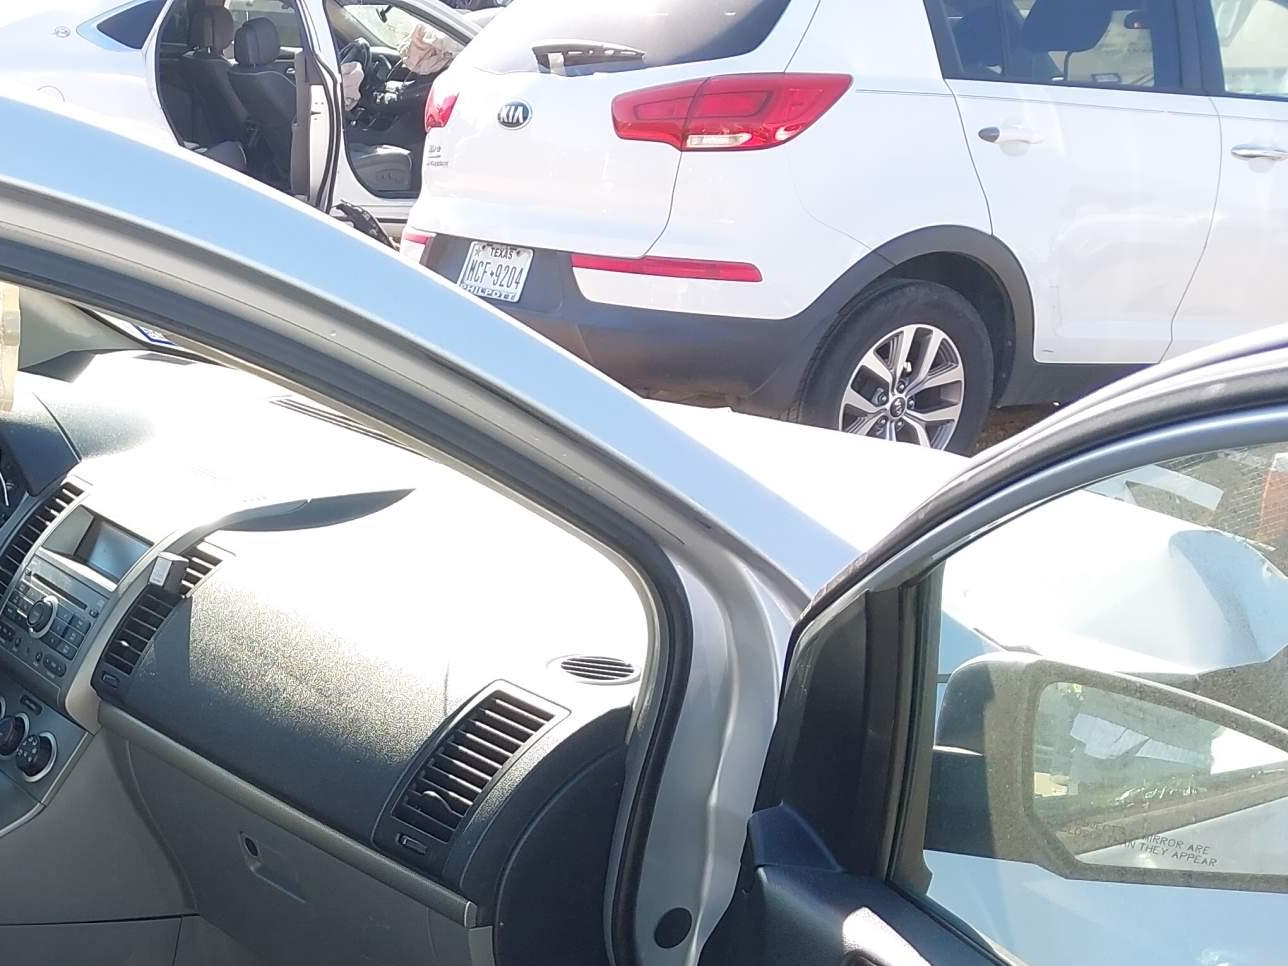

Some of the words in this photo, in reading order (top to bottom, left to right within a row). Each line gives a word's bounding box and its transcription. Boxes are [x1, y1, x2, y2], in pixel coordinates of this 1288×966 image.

[500, 104, 524, 124] KIA
[490, 247, 514, 260] TEXAS
[1139, 842, 1168, 856] THEY
[1171, 851, 1217, 867] APPEAR
[1187, 844, 1211, 856] ARE
